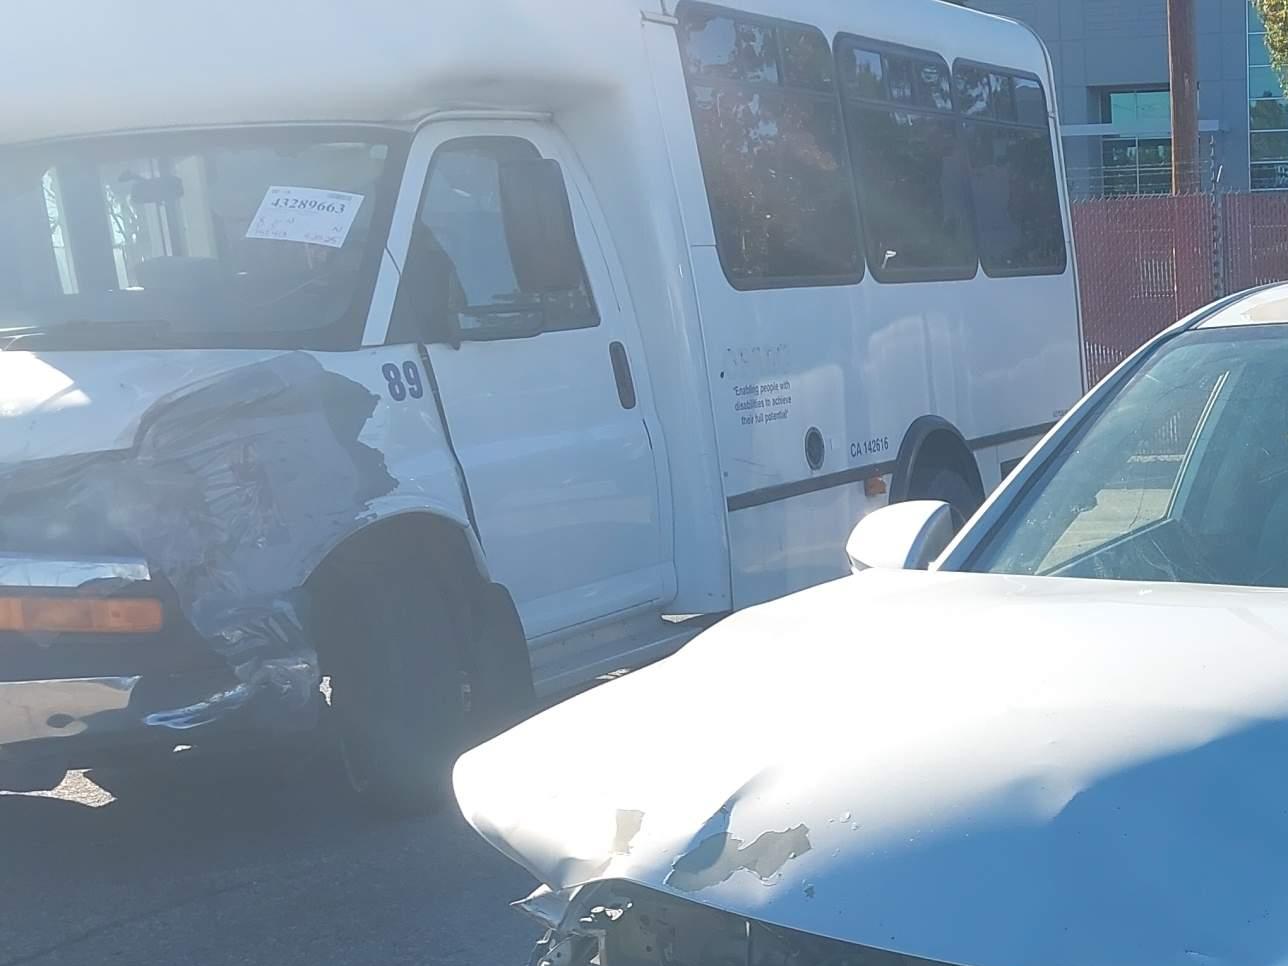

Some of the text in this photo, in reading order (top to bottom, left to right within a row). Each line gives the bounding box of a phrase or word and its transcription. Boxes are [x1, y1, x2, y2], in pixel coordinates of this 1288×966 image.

[272, 197, 346, 214] 43289663
[382, 361, 423, 401] 89
[760, 383, 779, 394] people
[772, 396, 791, 406] achieve
[850, 436, 889, 457] CA 142616
